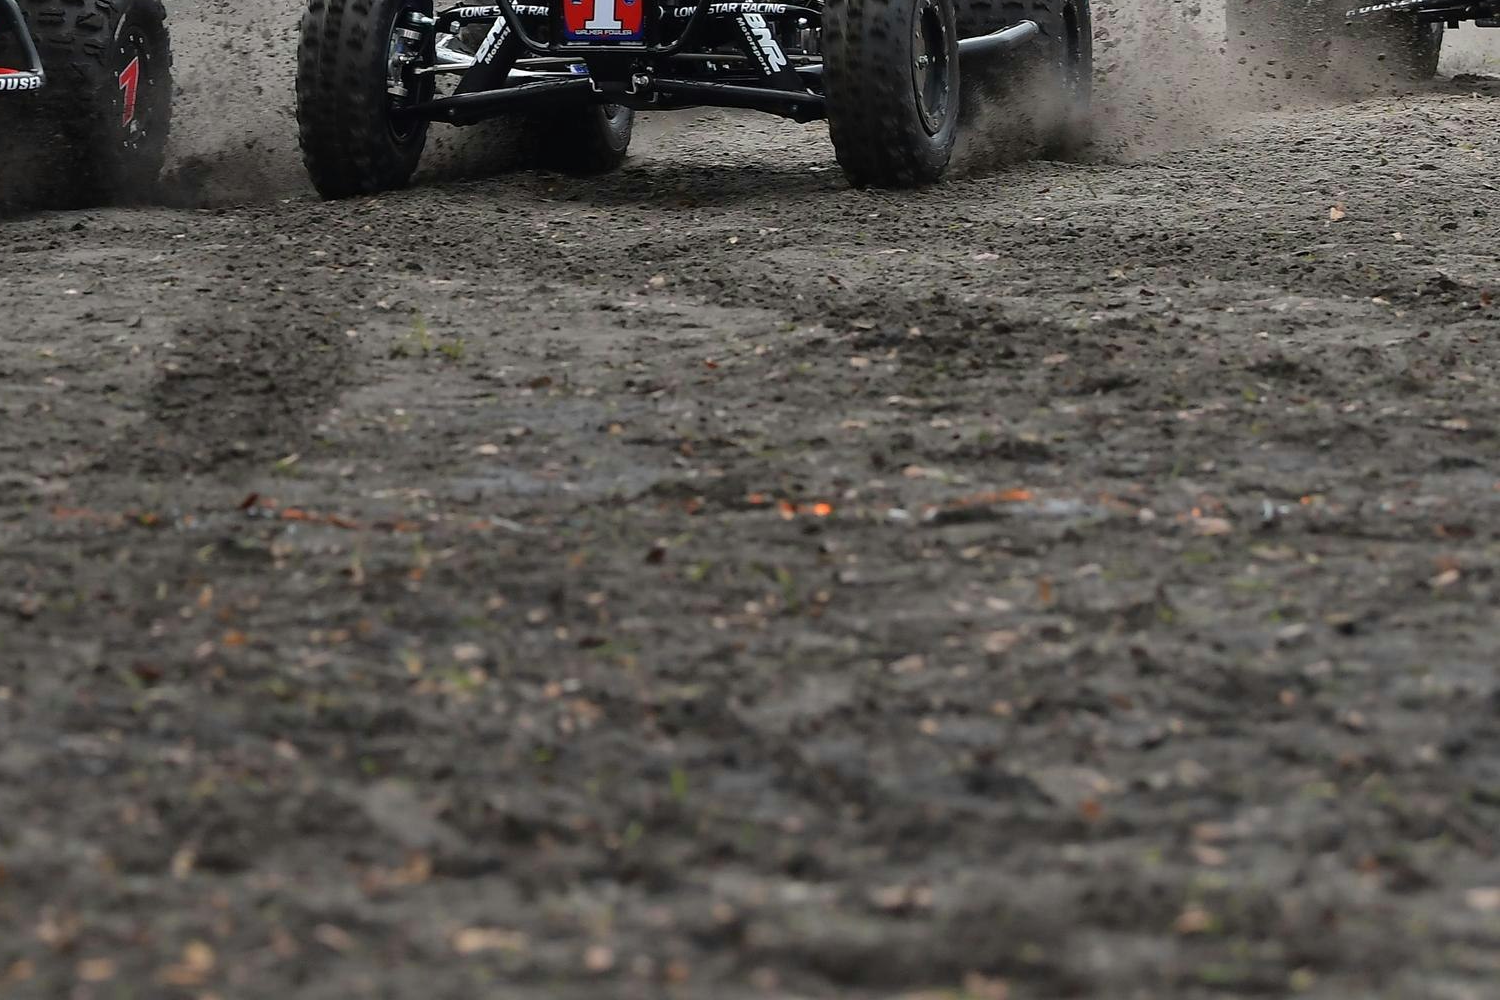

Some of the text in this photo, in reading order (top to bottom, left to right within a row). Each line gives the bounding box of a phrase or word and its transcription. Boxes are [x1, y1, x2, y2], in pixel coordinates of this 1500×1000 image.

[740, 3, 787, 14] RACING
[735, 16, 773, 76] Motorsports
[742, 13, 788, 73] BNR
